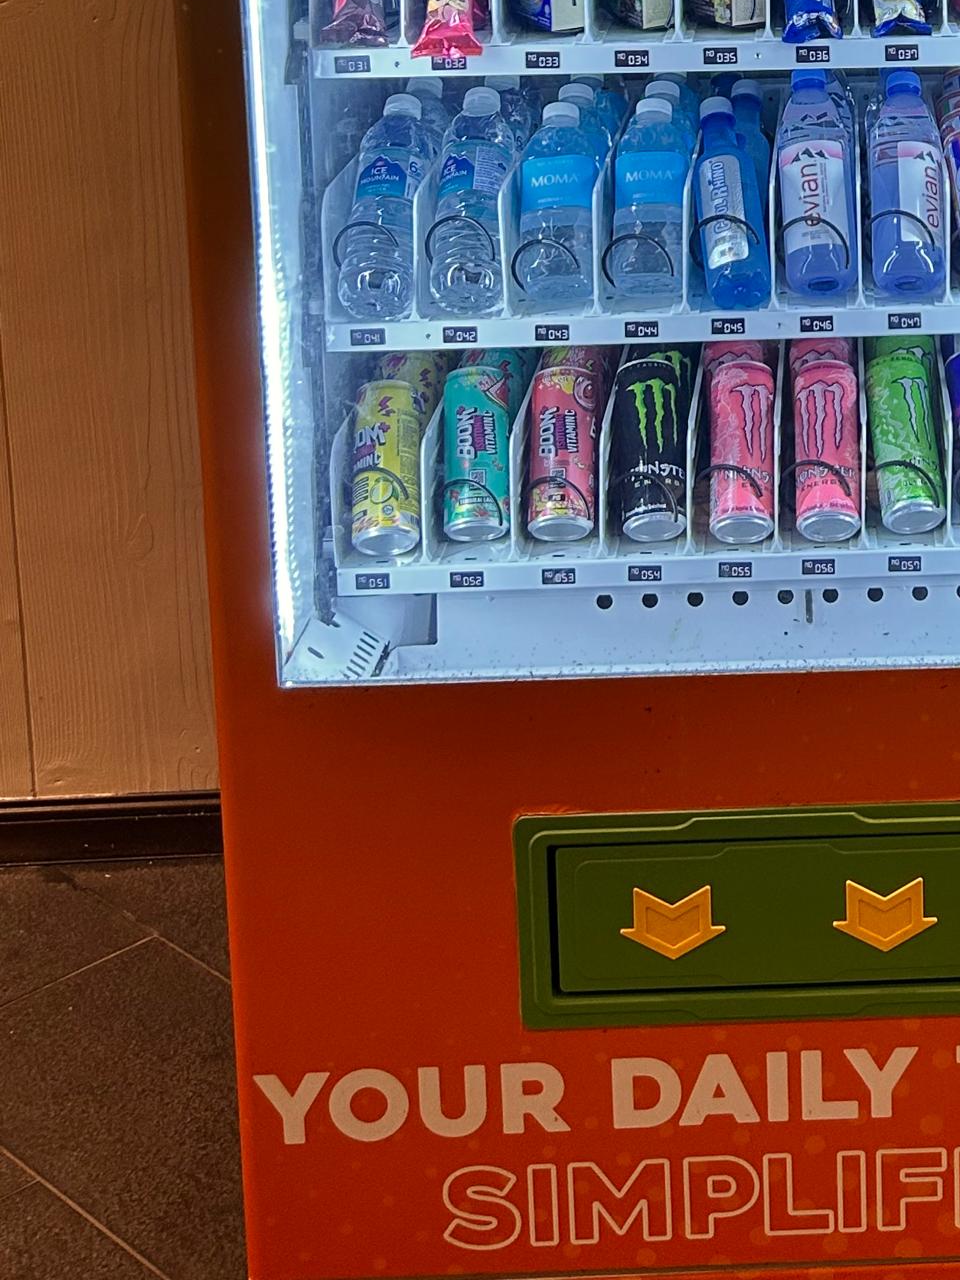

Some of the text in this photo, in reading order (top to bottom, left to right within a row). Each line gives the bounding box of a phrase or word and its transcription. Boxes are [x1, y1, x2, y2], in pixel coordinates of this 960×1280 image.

[628, 56, 647, 64] 034
[717, 53, 736, 62] 035
[810, 51, 828, 60] 036
[539, 57, 558, 66] 033
[371, 166, 389, 175] ICE
[799, 160, 822, 227] evian
[926, 164, 941, 228] evian
[724, 323, 742, 332] 045
[813, 320, 832, 330] 046
[549, 330, 568, 339] 043
[638, 327, 656, 336] 044
[456, 332, 475, 341] 042
[567, 418, 578, 454] VITAMIN
[732, 567, 750, 576] 055
[815, 564, 833, 572] 056
[554, 571, 574, 582] 053
[642, 570, 660, 579] 054
[463, 576, 481, 585] 052
[252, 1061, 570, 1145] YOUR
[610, 1046, 920, 1130] DAILY
